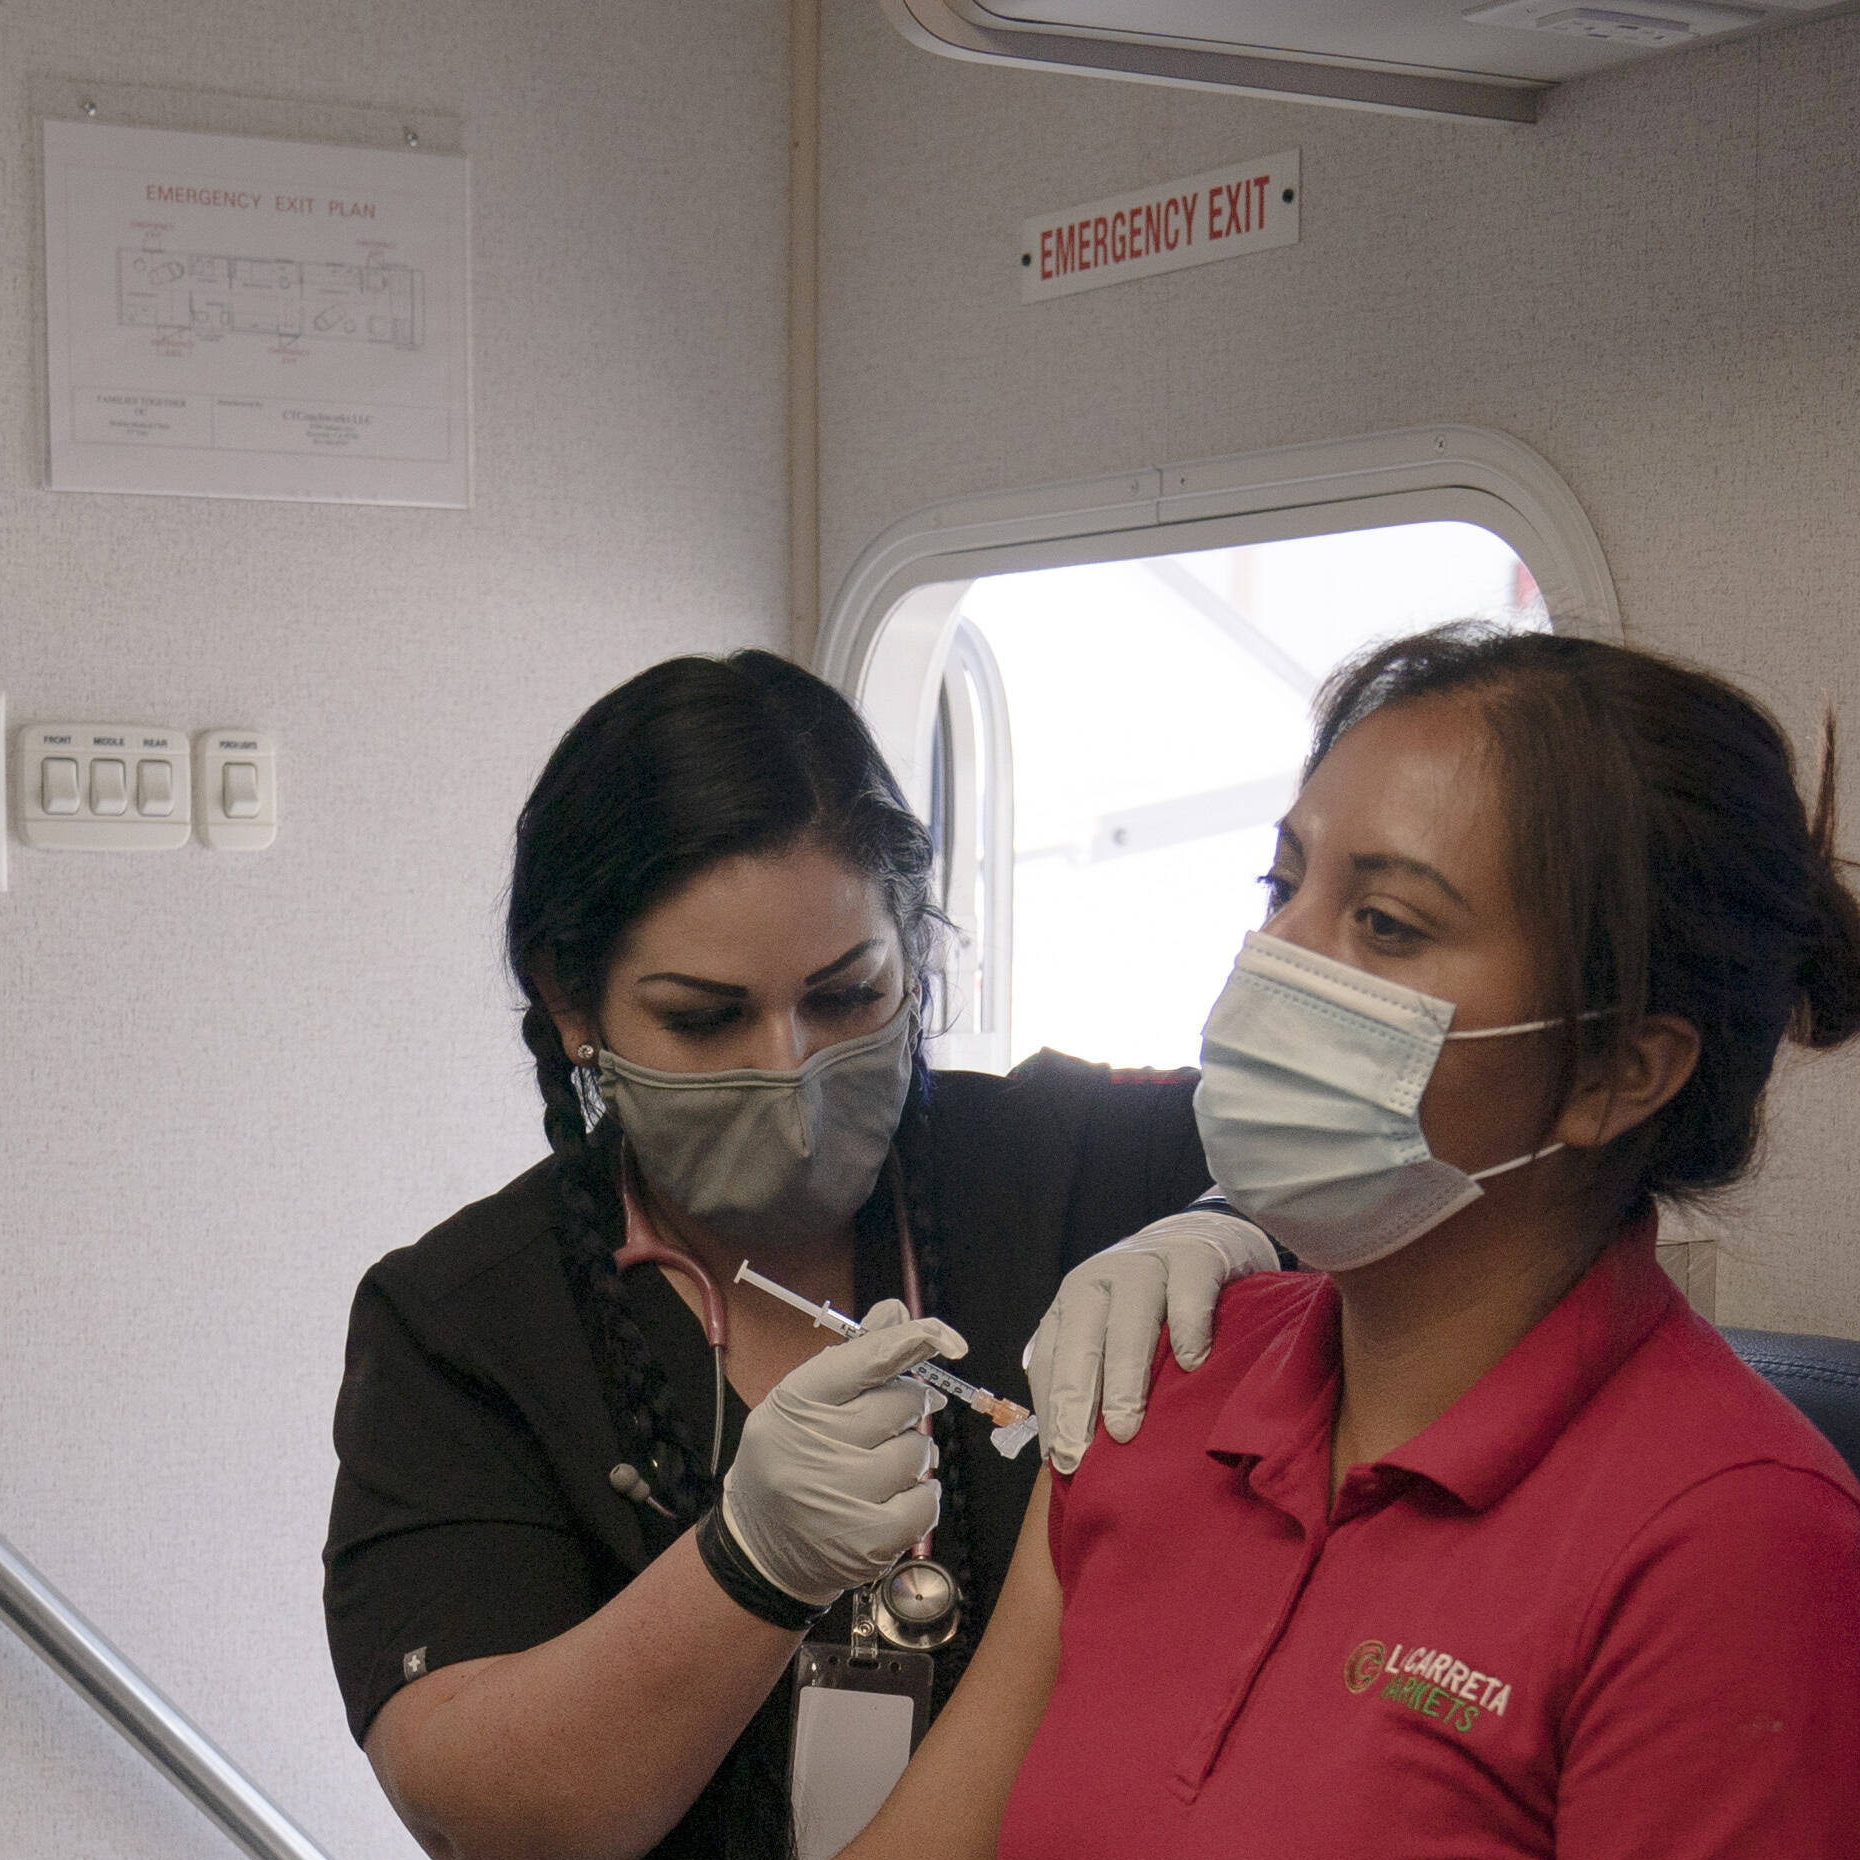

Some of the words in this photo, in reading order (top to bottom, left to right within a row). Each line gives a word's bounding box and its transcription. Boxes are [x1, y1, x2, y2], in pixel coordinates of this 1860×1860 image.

[146, 184, 262, 210] EMERGENCY
[275, 195, 316, 214] EXIT
[329, 200, 376, 219] PLAN
[1040, 192, 1199, 280] EMERGENCY
[1208, 175, 1270, 240] EXIT
[44, 735, 71, 745] FRONT
[93, 737, 125, 746] MIDDLE
[143, 739, 168, 748] REAR
